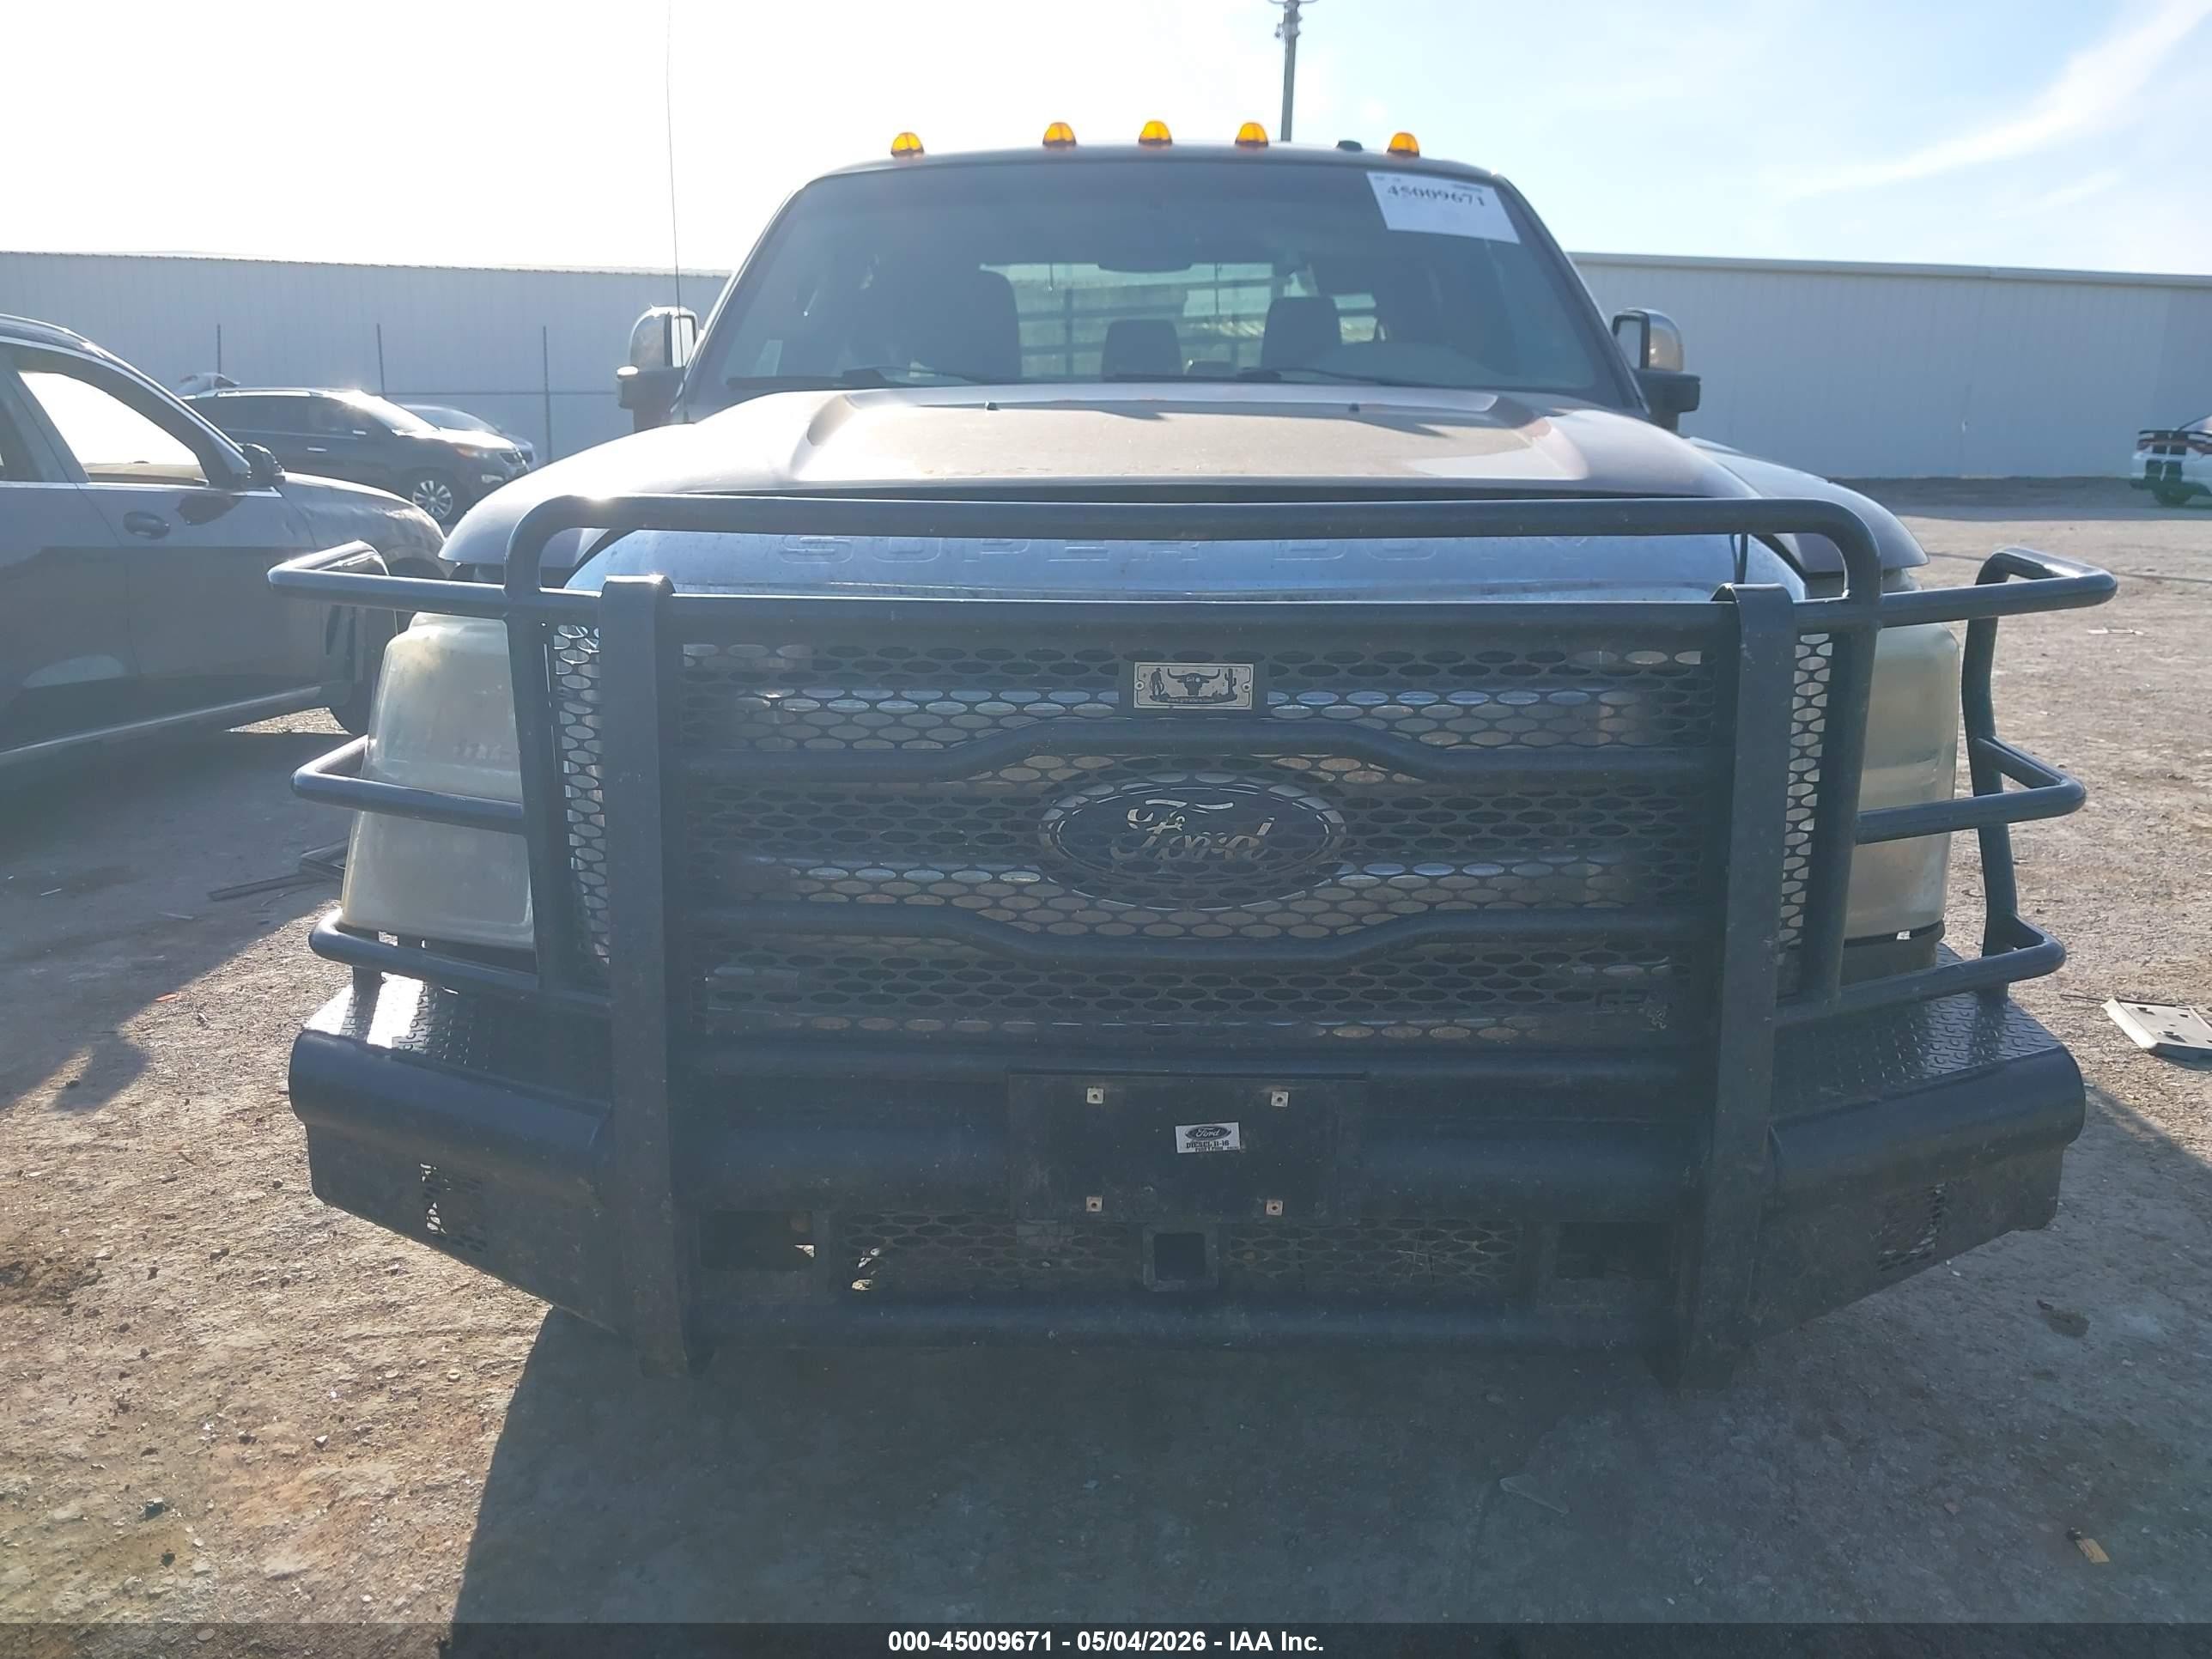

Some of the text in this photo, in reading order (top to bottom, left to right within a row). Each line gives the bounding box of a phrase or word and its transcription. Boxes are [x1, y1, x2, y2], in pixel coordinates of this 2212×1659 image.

[1110, 799, 1277, 860] Ford
[1194, 1127, 1221, 1138] Ford
[1186, 1140, 1212, 1149] DIESEL
